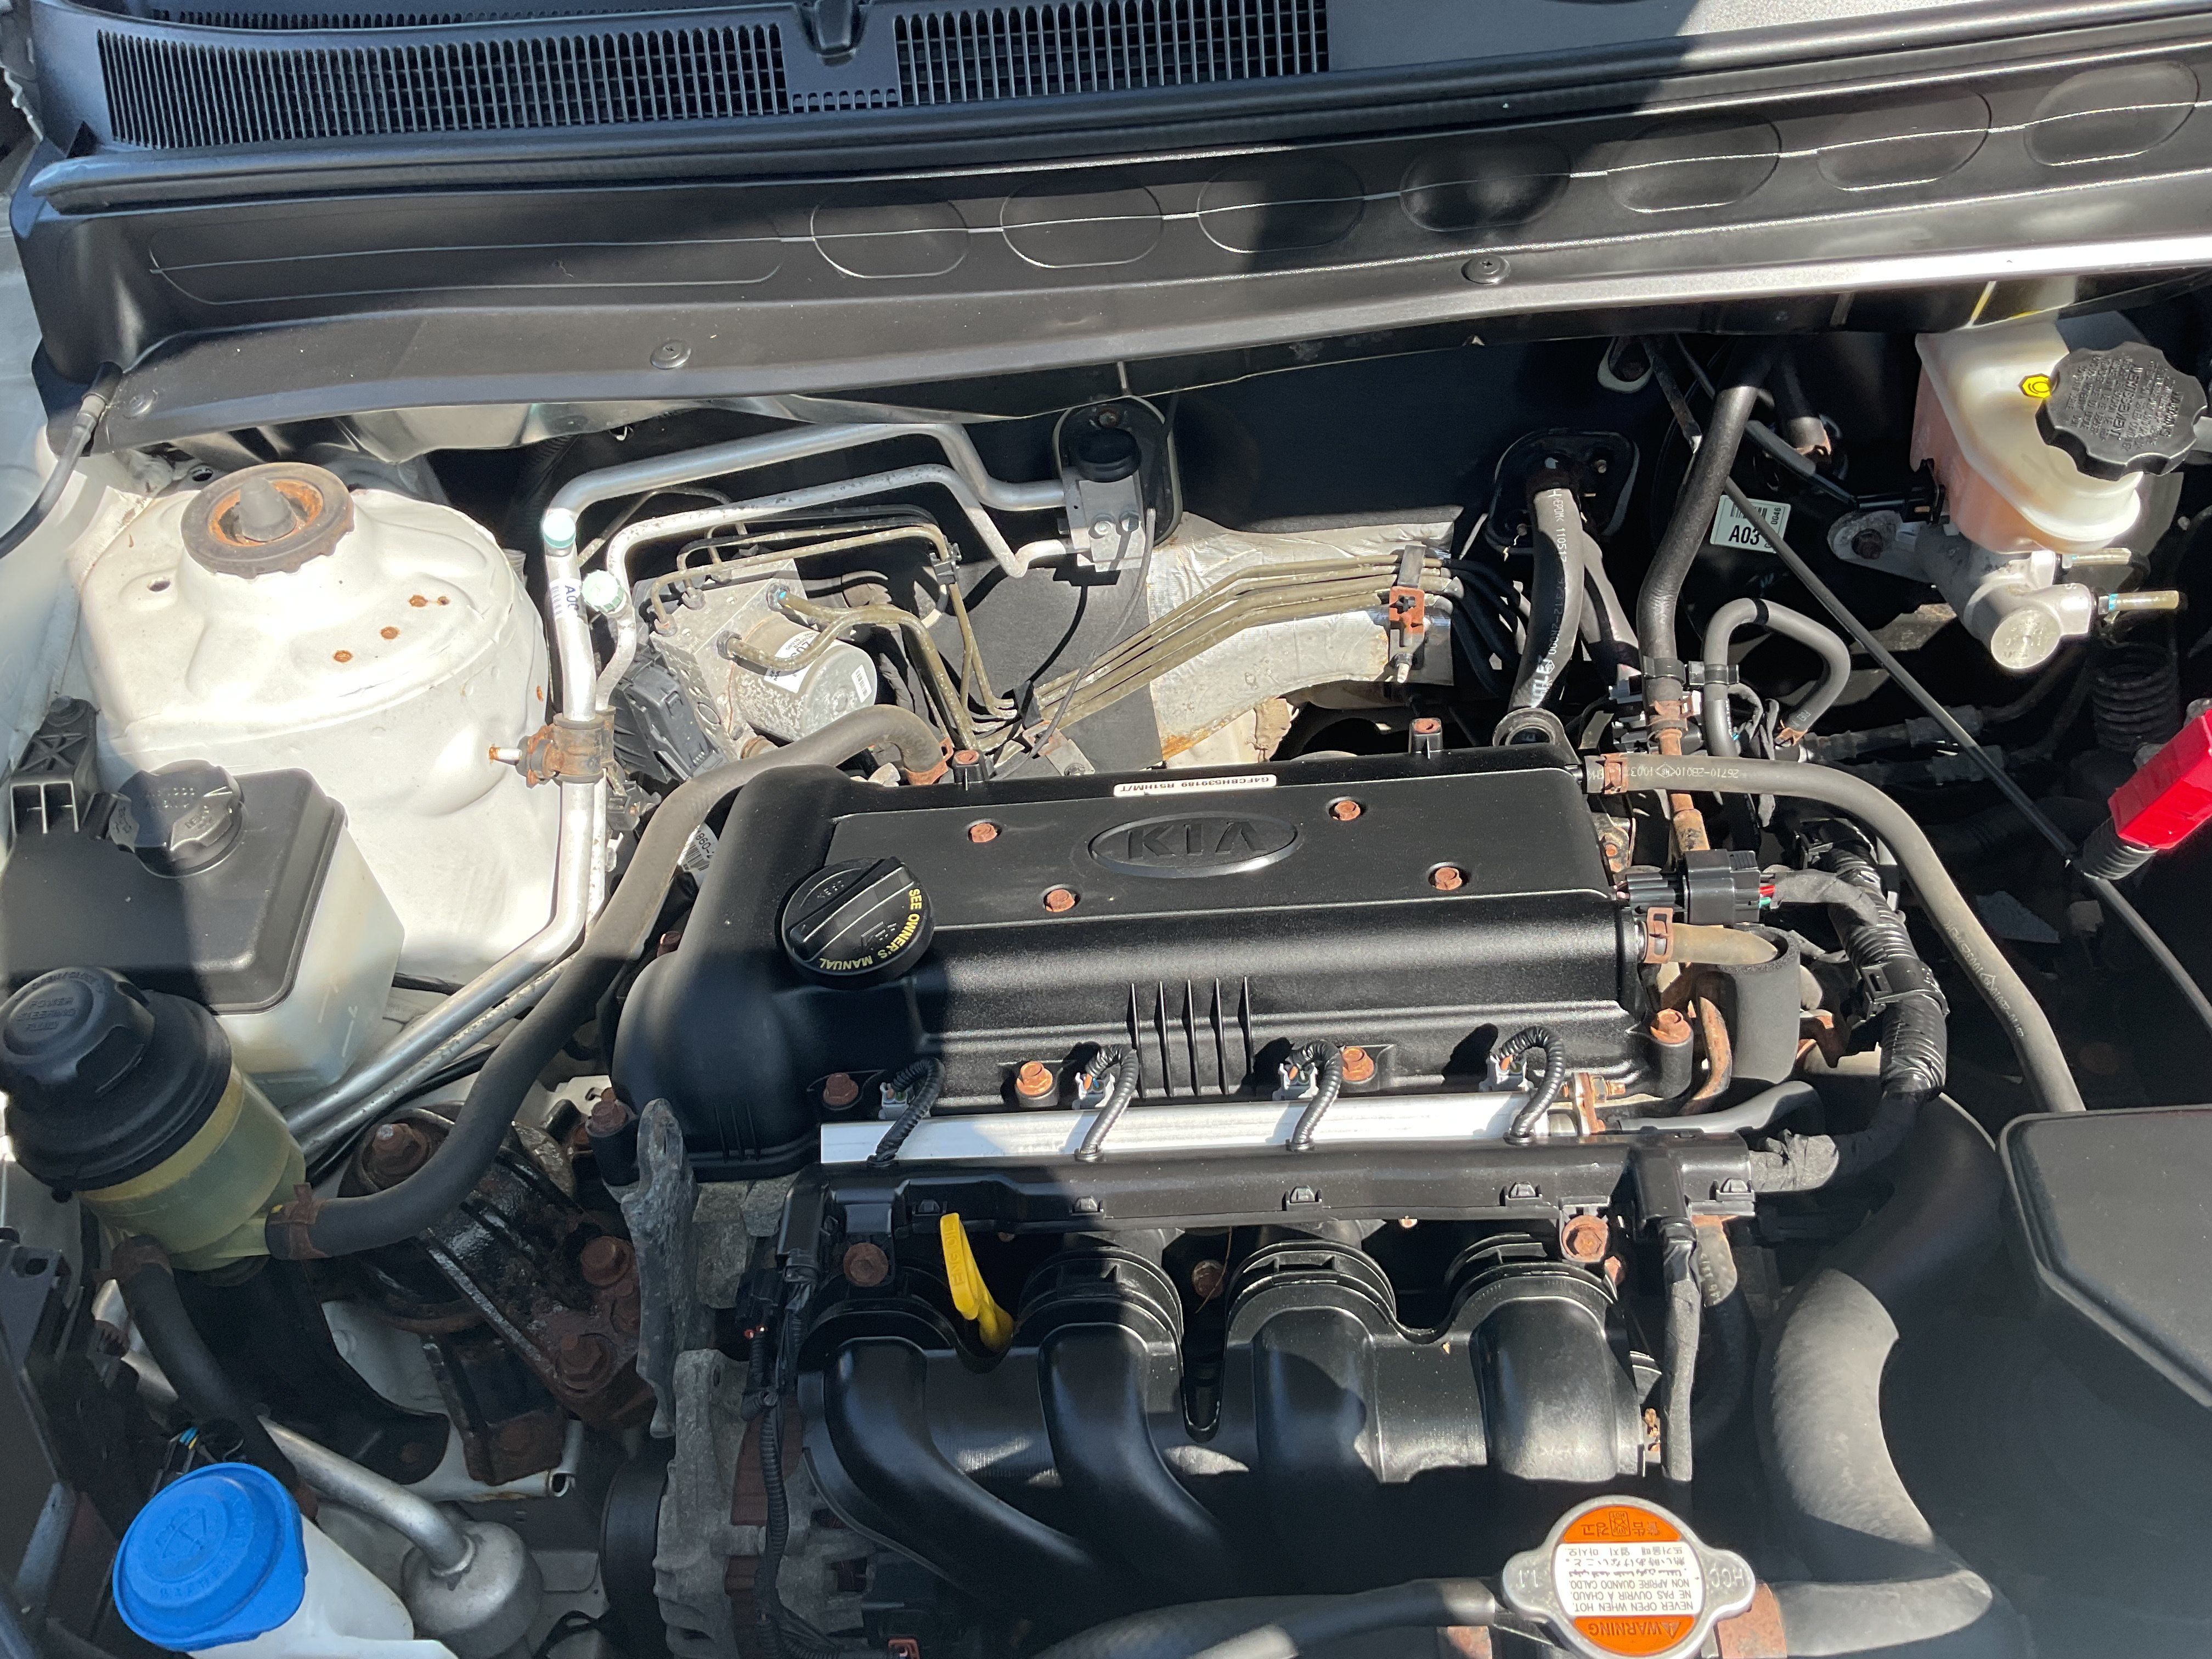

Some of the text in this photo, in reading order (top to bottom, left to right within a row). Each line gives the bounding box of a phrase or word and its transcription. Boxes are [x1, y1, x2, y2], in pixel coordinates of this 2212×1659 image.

[1770, 506, 1781, 525] 0046
[1728, 524, 1760, 545] A03
[1128, 823, 1267, 859] KIA
[820, 888, 922, 970] SEE OWNER'S MANUAL
[945, 1224, 964, 1284] ENG OIL
[1517, 1568, 1539, 1588] 1.1
[1569, 1579, 1689, 1589] NON APRIRE QUANDO CALDO.
[1709, 1567, 1745, 1588] HCC
[1571, 1592, 1603, 1600] CHAUD.
[1618, 1591, 1652, 1600] OUVRIR
[1657, 1590, 1674, 1599] PAS
[1679, 1590, 1691, 1598] NE
[1573, 1601, 1693, 1611] NEVER OPEN WHEN HOT.
[1588, 1622, 1661, 1636] WARNING
